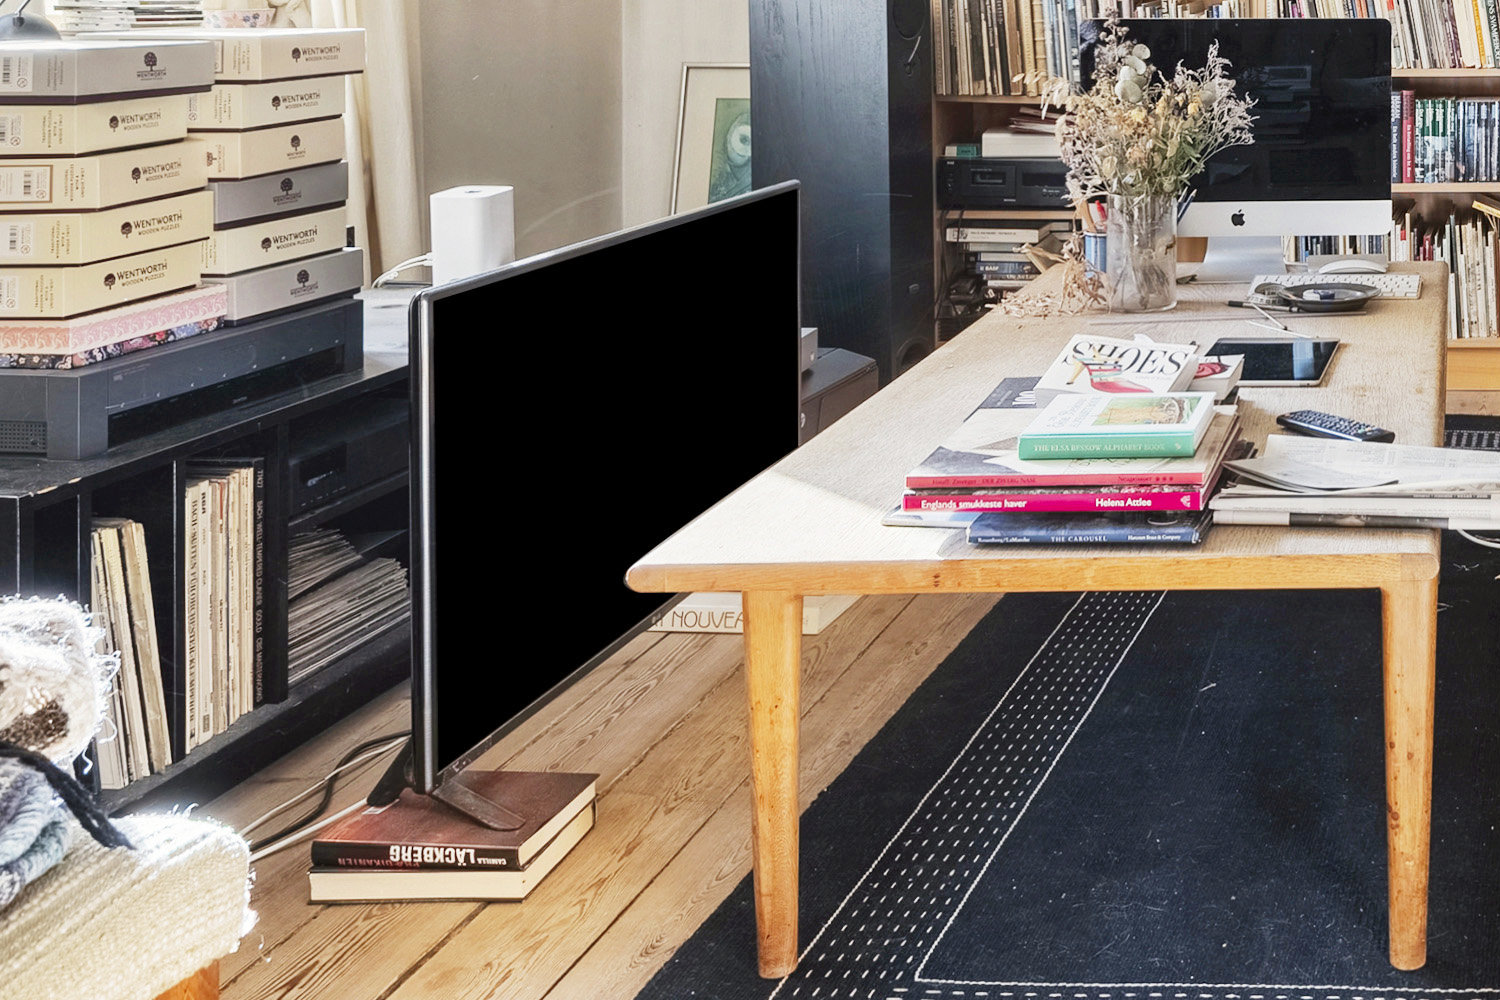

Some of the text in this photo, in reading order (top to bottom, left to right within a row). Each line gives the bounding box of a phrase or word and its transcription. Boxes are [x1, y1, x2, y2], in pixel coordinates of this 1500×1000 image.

[302, 46, 341, 56] WENTWORTH
[282, 92, 320, 103] WENTWORTH
[120, 111, 161, 123] WENTWORTH
[141, 161, 182, 175] WENTWORTH
[133, 212, 183, 230] WENTWORTH
[272, 227, 318, 244] WENTWORTH
[116, 262, 168, 280] WENTWORTH
[1063, 340, 1189, 376] SHOES
[1051, 443, 1071, 451] ELSA
[1104, 443, 1142, 451] ALPHABET
[921, 498, 1152, 510] Englands smukkeste haver Helena Attlee
[255, 609, 264, 633] GOULD
[389, 845, 507, 866] LÄCKBERG CAMILLA
